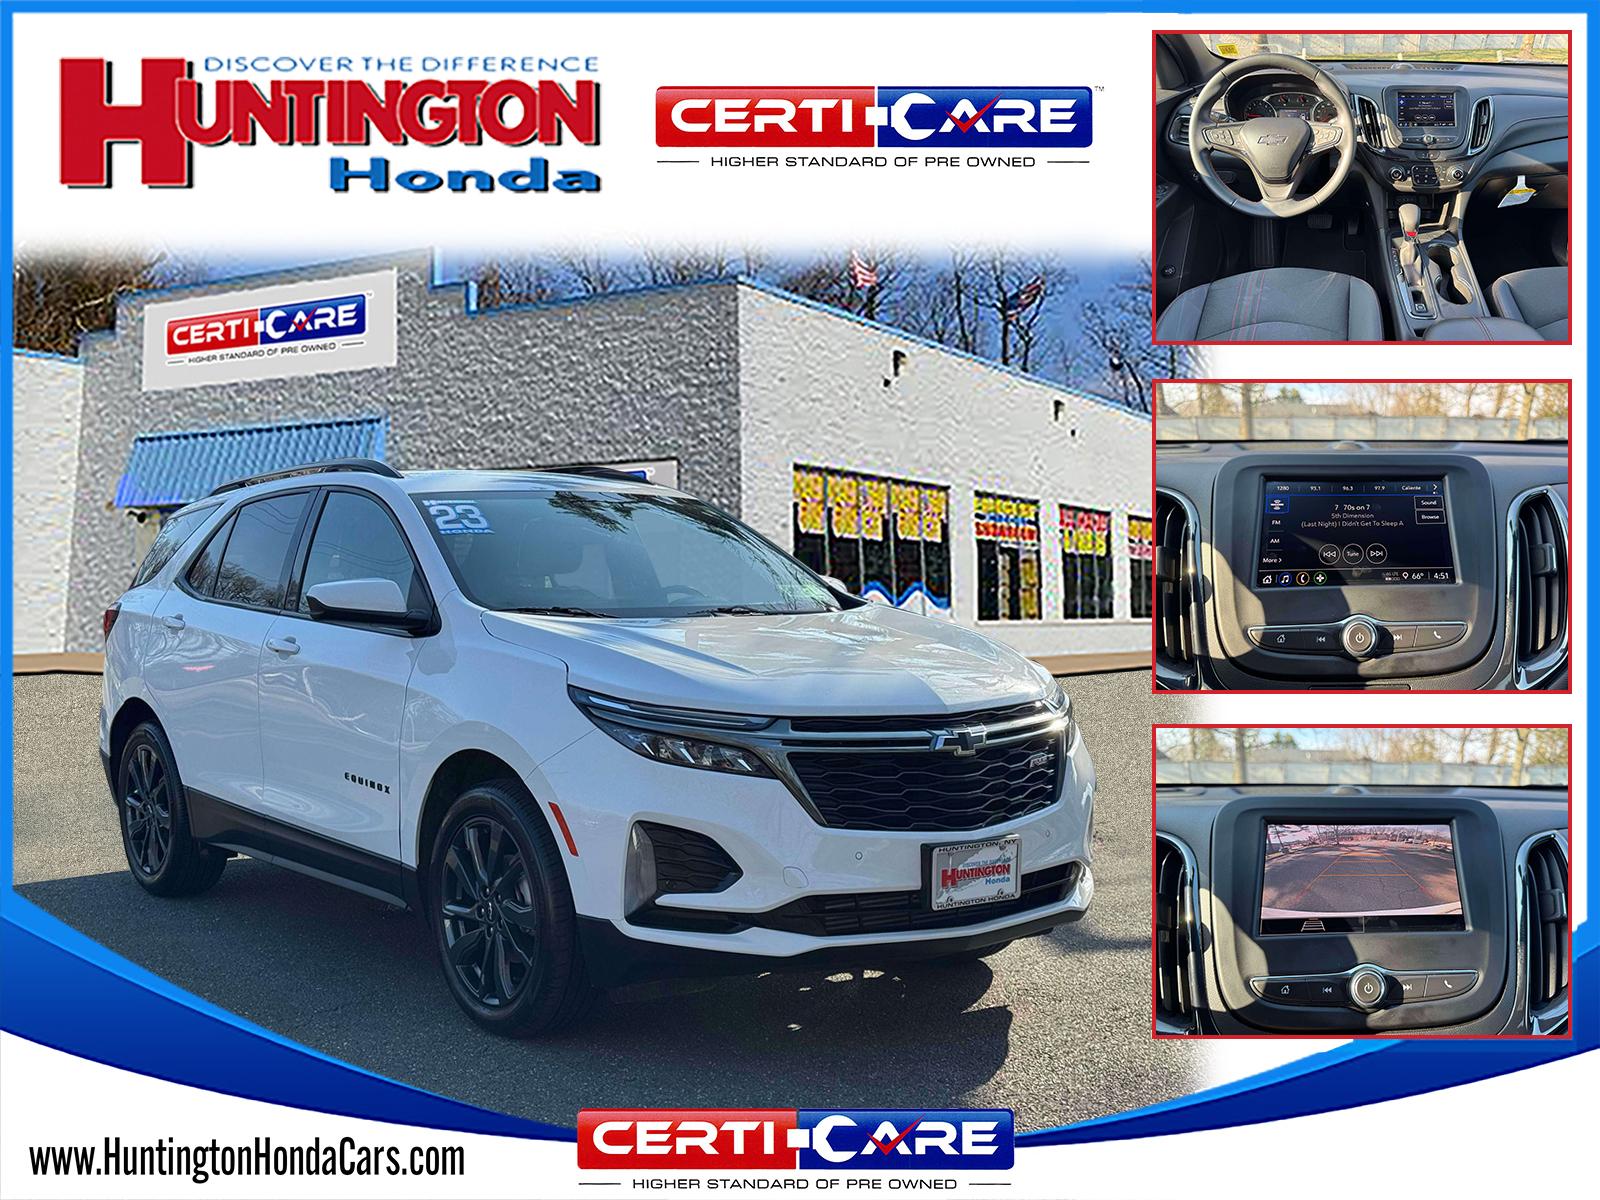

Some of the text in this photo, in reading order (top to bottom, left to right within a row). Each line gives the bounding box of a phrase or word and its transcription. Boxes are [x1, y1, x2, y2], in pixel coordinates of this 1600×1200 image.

[188, 342, 336, 364] HIGHER STANDARD OF PRE OWNED
[1334, 503, 1339, 511] 7
[1343, 503, 1355, 511] 70s
[1366, 503, 1371, 511] 7
[428, 504, 489, 530] 23
[1301, 520, 1317, 529] (Last
[1318, 520, 1337, 529] Night)
[1381, 520, 1398, 528] Sleep
[344, 771, 391, 795] EQUINOX
[941, 863, 1011, 889] HUNTINGTON
[985, 876, 1011, 885] Honda
[937, 893, 1016, 909] HUNTINGTON HONDA
